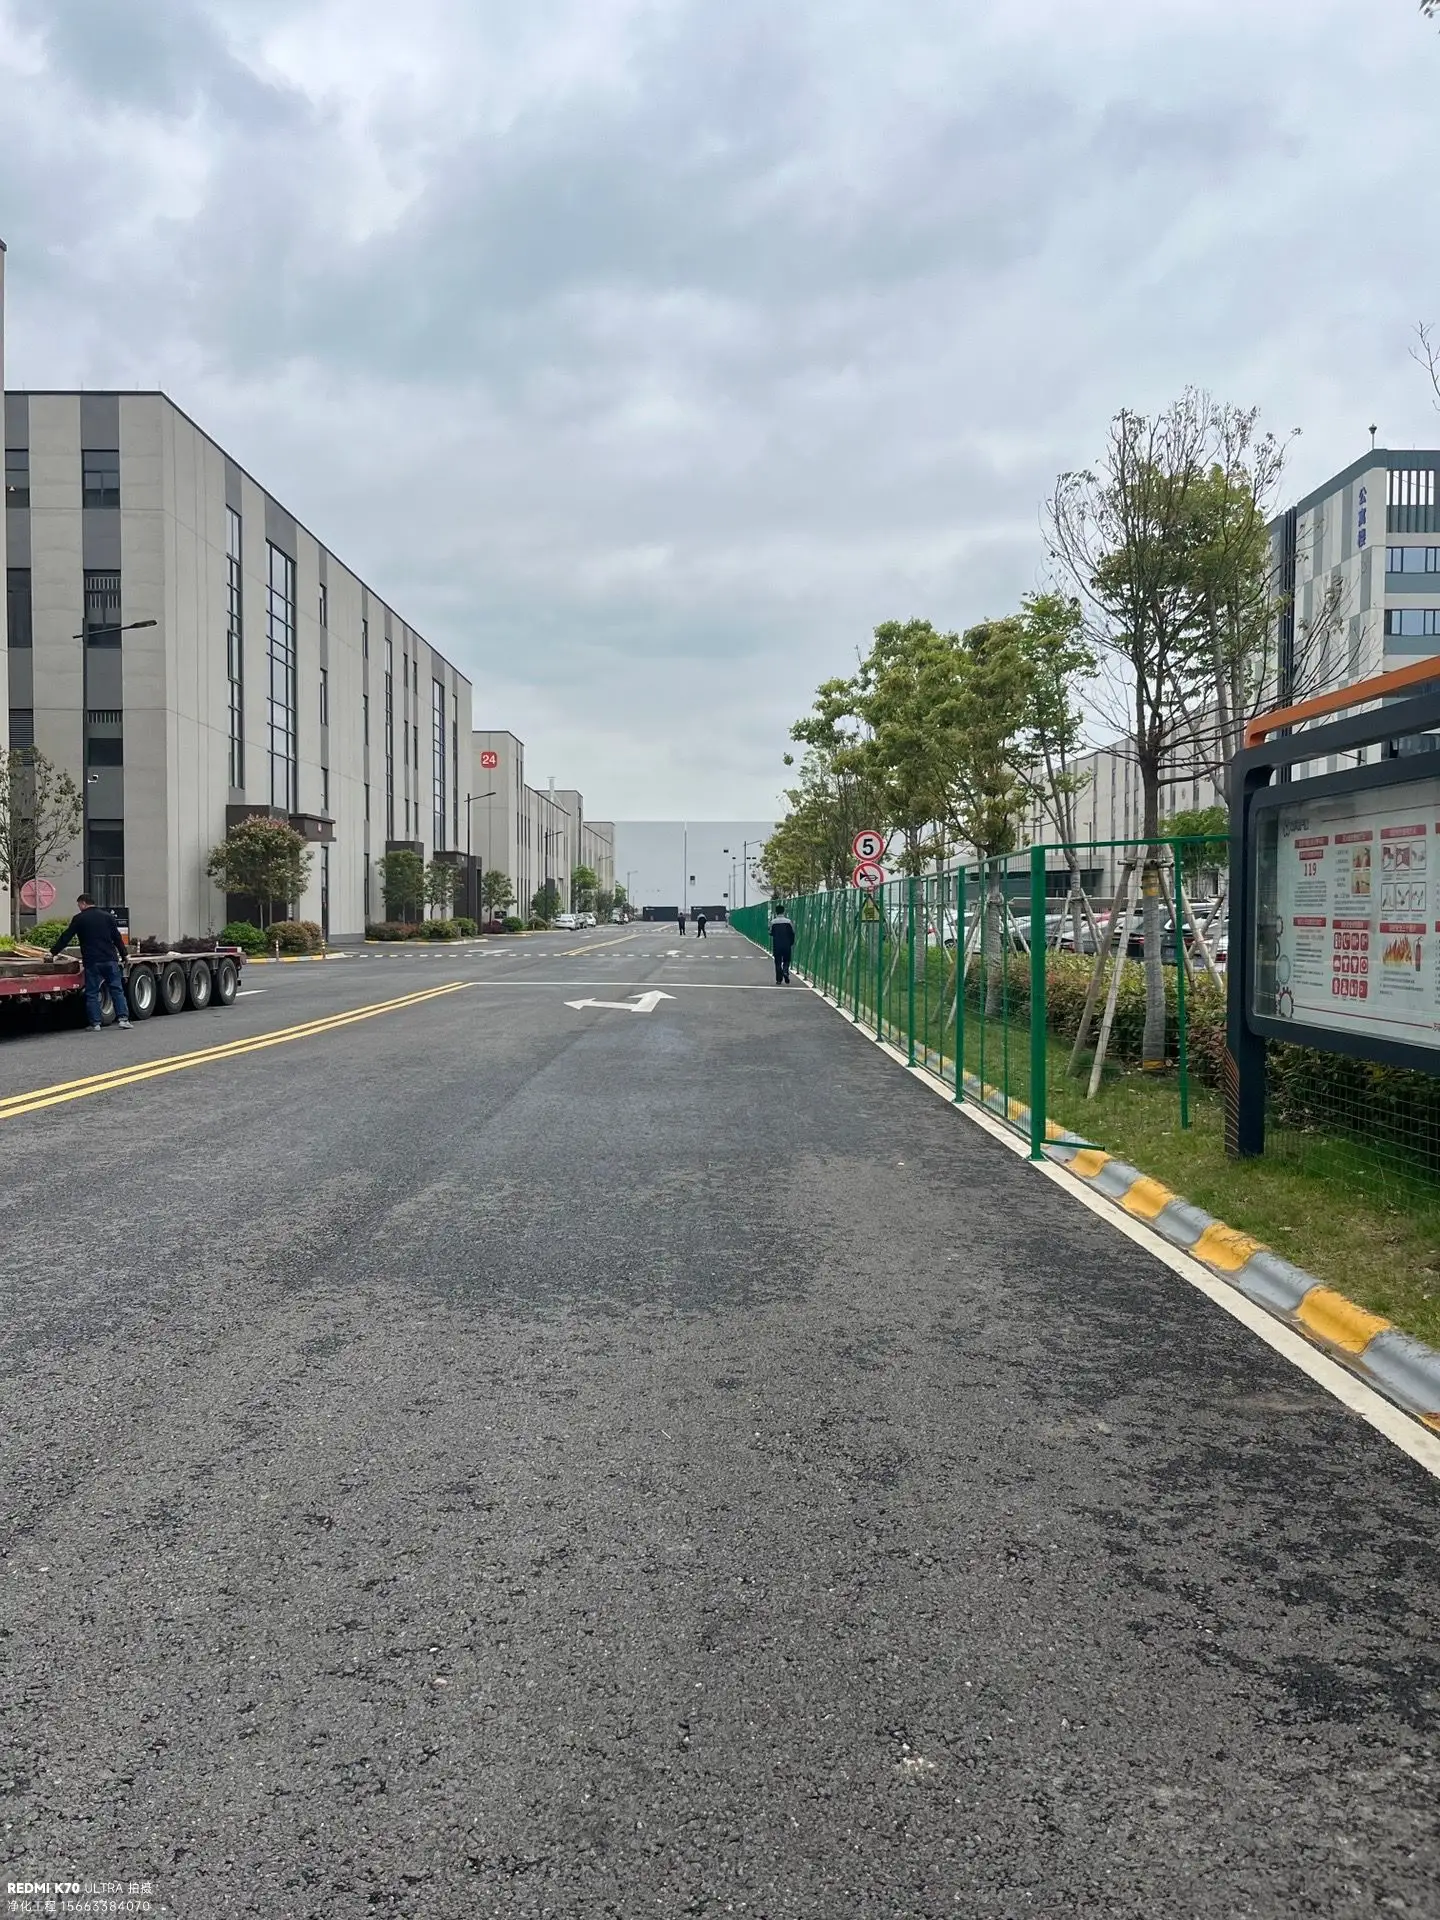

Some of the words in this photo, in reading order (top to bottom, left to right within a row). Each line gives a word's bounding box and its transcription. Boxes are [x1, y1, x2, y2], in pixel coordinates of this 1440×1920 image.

[482, 754, 496, 765] 24
[862, 838, 874, 856] 5
[1303, 862, 1317, 877] 119
